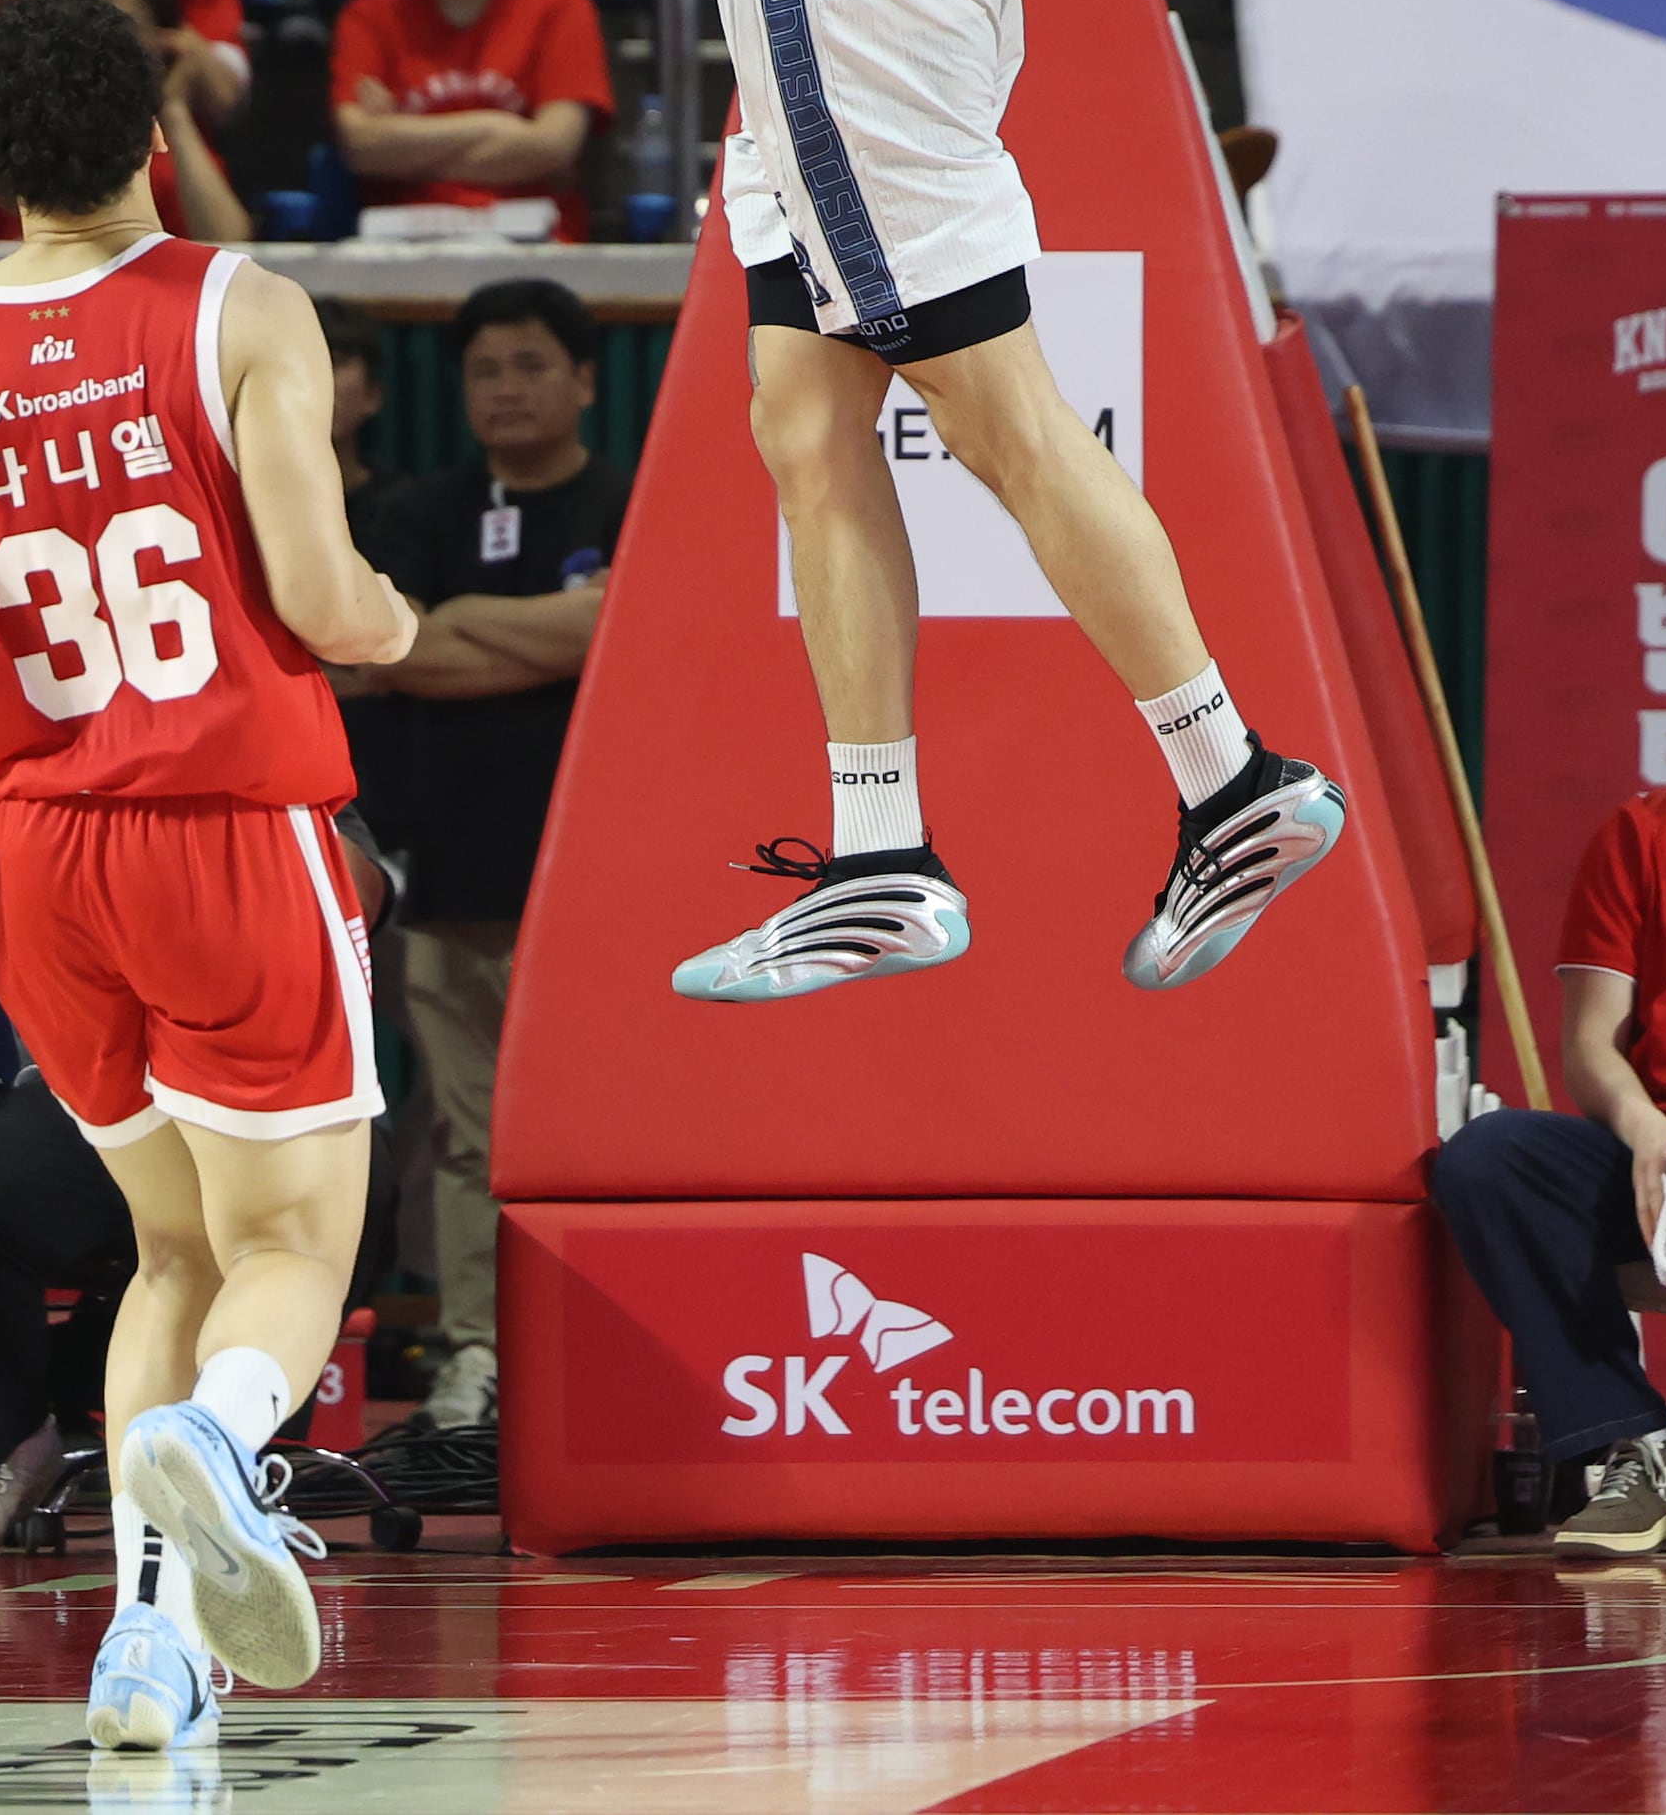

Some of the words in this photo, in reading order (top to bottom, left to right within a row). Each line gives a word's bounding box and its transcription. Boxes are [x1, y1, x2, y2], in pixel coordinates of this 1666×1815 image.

[30, 338, 76, 366] KBL
[15, 365, 145, 419] broadband
[1156, 690, 1225, 736] sono
[831, 768, 901, 785] sono
[720, 1354, 853, 1437] SK
[889, 1367, 1195, 1436] telecom
